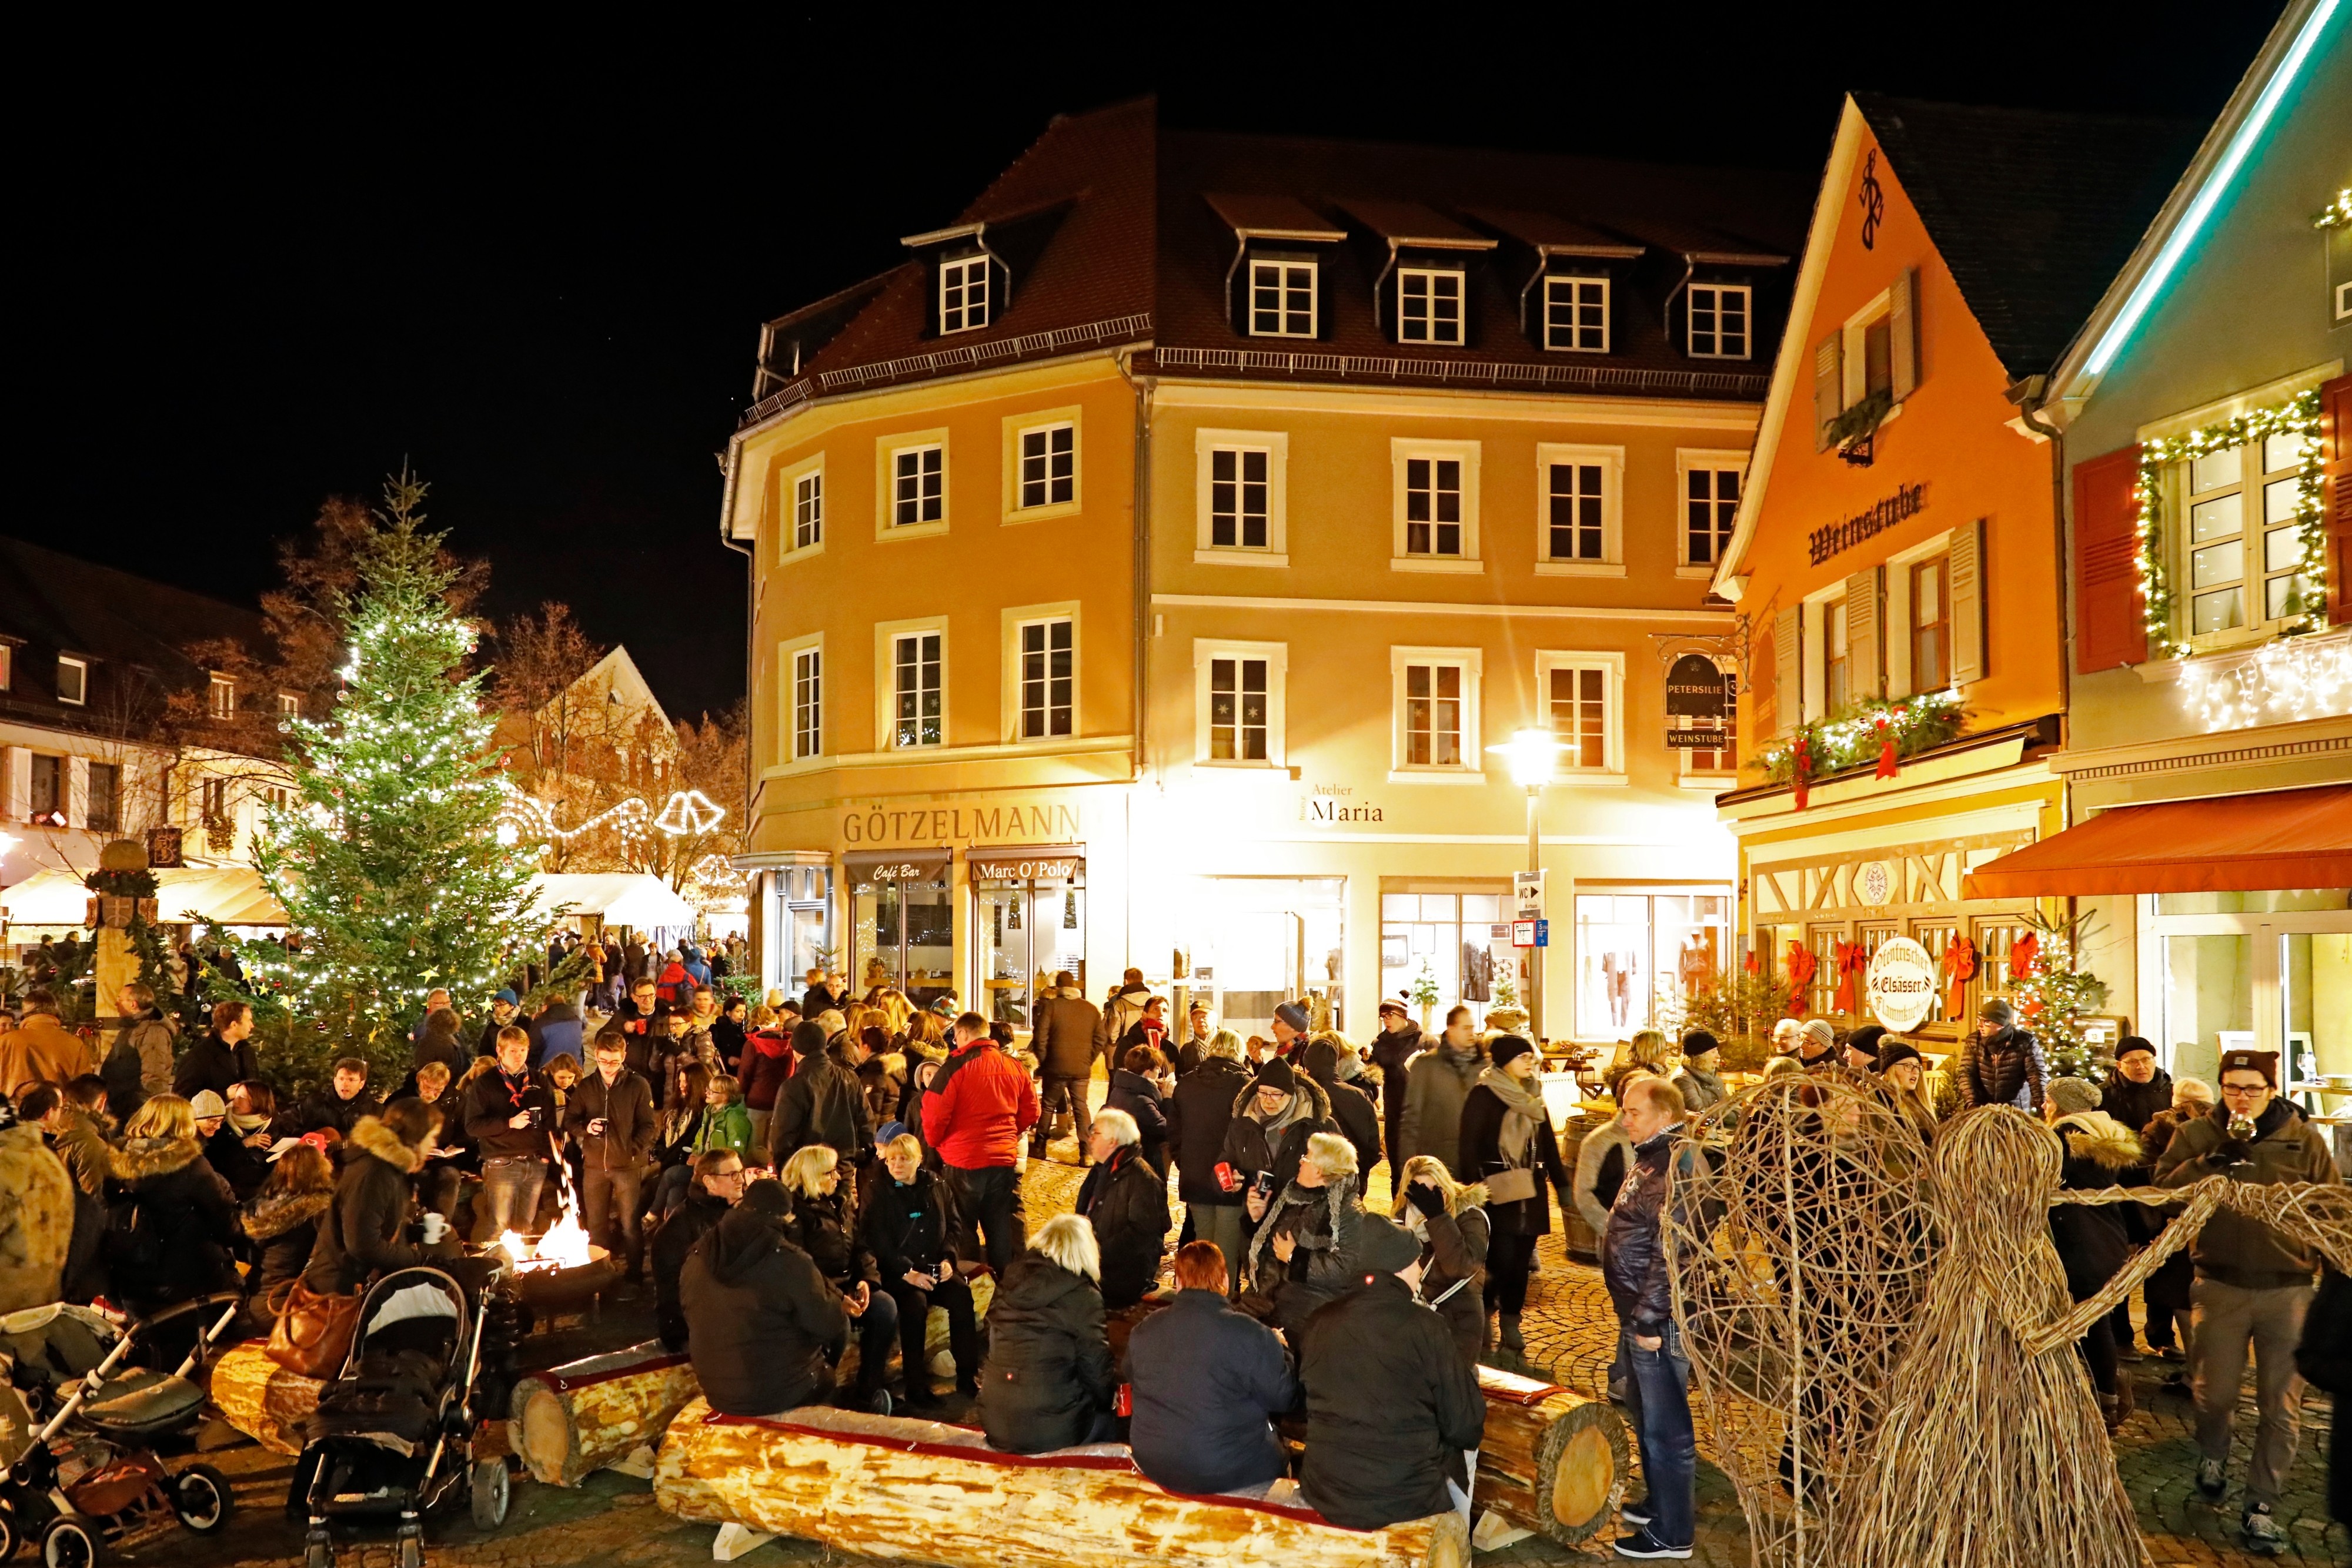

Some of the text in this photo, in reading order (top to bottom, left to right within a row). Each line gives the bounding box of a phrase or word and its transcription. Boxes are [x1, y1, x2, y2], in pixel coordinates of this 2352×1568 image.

[1808, 483, 1922, 569] Weinstube
[1668, 685, 1723, 694] PETERSILIE
[1669, 734, 1724, 744] WEINSTUBE
[1312, 783, 1353, 795] Atelier
[1311, 801, 1384, 822] Maria
[843, 804, 1080, 842] GÖTZELMANN
[873, 864, 920, 882] Café Bar
[981, 864, 1015, 878] Marc
[1038, 861, 1070, 877] Polo
[1519, 888, 1528, 899] WC
[1874, 943, 1928, 974] Ofenfrischer
[1881, 976, 1922, 993] Elsässer
[1873, 996, 1930, 1022] Flammkuchen
